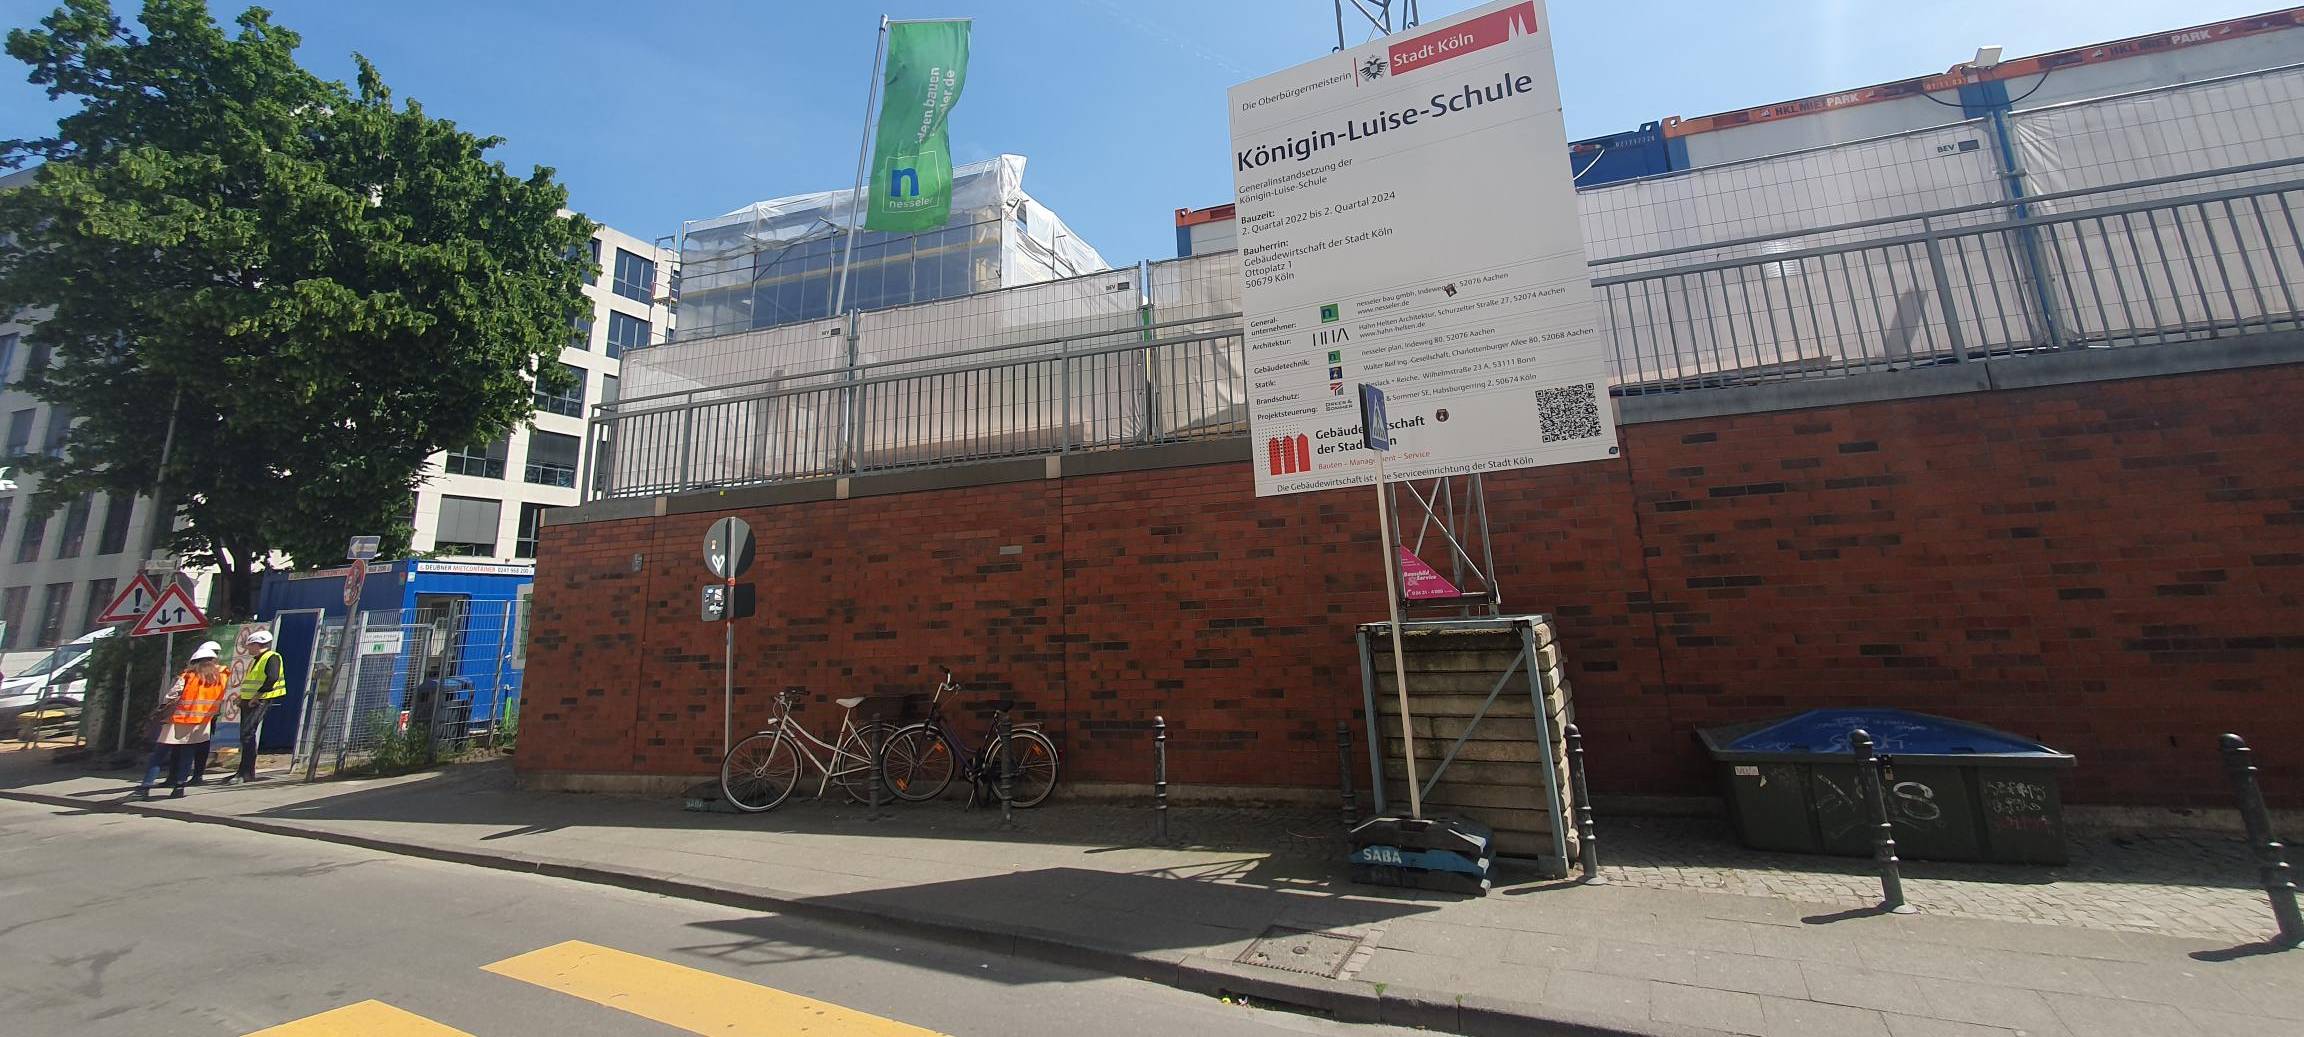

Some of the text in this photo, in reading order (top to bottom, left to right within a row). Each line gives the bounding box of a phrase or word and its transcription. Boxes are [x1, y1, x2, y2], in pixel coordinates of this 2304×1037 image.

[1393, 33, 1474, 67] Stadt Köln
[924, 67, 940, 108] bauen
[1242, 72, 1352, 112] Die Oberbürgermeisterin
[1238, 72, 1532, 172] Königin-Luise-Schule
[1937, 144, 1955, 153] BEV
[891, 168, 919, 198] n
[1239, 158, 1353, 194] Generalinstandsetzung der
[1240, 176, 1328, 204] Königin-Luise-Schule
[1241, 210, 1276, 224] Bauzeit:
[1242, 191, 1396, 236] 2. Quartal 2022 bis 2. Quartal 2024
[1244, 226, 1394, 267] Gebäudewirtschaft der Stadt Köln
[1244, 238, 1289, 256] Bauherrin:
[1245, 262, 1286, 278] Ottoplatz
[1482, 273, 1508, 282] Aachen
[1245, 271, 1295, 289] 50679 Köln
[1358, 322, 1376, 330] Hahn
[1476, 299, 1499, 310] Straße
[1514, 292, 1537, 302] 52074
[1538, 287, 1566, 297] Aachen
[1250, 316, 1278, 328] General-
[1252, 323, 1297, 336] unternehmer:
[1252, 340, 1292, 351] Architektur:
[1388, 344, 1404, 354] plan,
[1446, 332, 1468, 342] 52076
[1470, 328, 1496, 337] Aachen
[1452, 342, 1510, 357] Charlottenburger
[1510, 338, 1528, 347] Allee
[1542, 332, 1565, 342] 52068
[1566, 328, 1594, 338] Aachen
[1254, 360, 1310, 375] Gebäudetechnik:
[1516, 356, 1536, 364] Bonn
[1256, 380, 1276, 389] Statik:
[1496, 376, 1518, 386] 50674
[1520, 373, 1536, 382] Köln
[1256, 393, 1301, 406] Brandschutz:
[1258, 406, 1318, 420] Projektsteuerung:
[1317, 440, 1363, 454] der Stad
[1318, 460, 1342, 470] Bauten
[1404, 450, 1431, 460] Service
[1278, 483, 1290, 492] Die
[1290, 476, 1362, 492] Gebäudewirtschaft
[1364, 474, 1374, 482] ist
[1392, 464, 1470, 480] Serviceeinrichtung
[1472, 462, 1486, 471] der
[1488, 458, 1512, 468] Stadt
[1514, 456, 1534, 465] Köln
[1362, 848, 1402, 864] SABA
